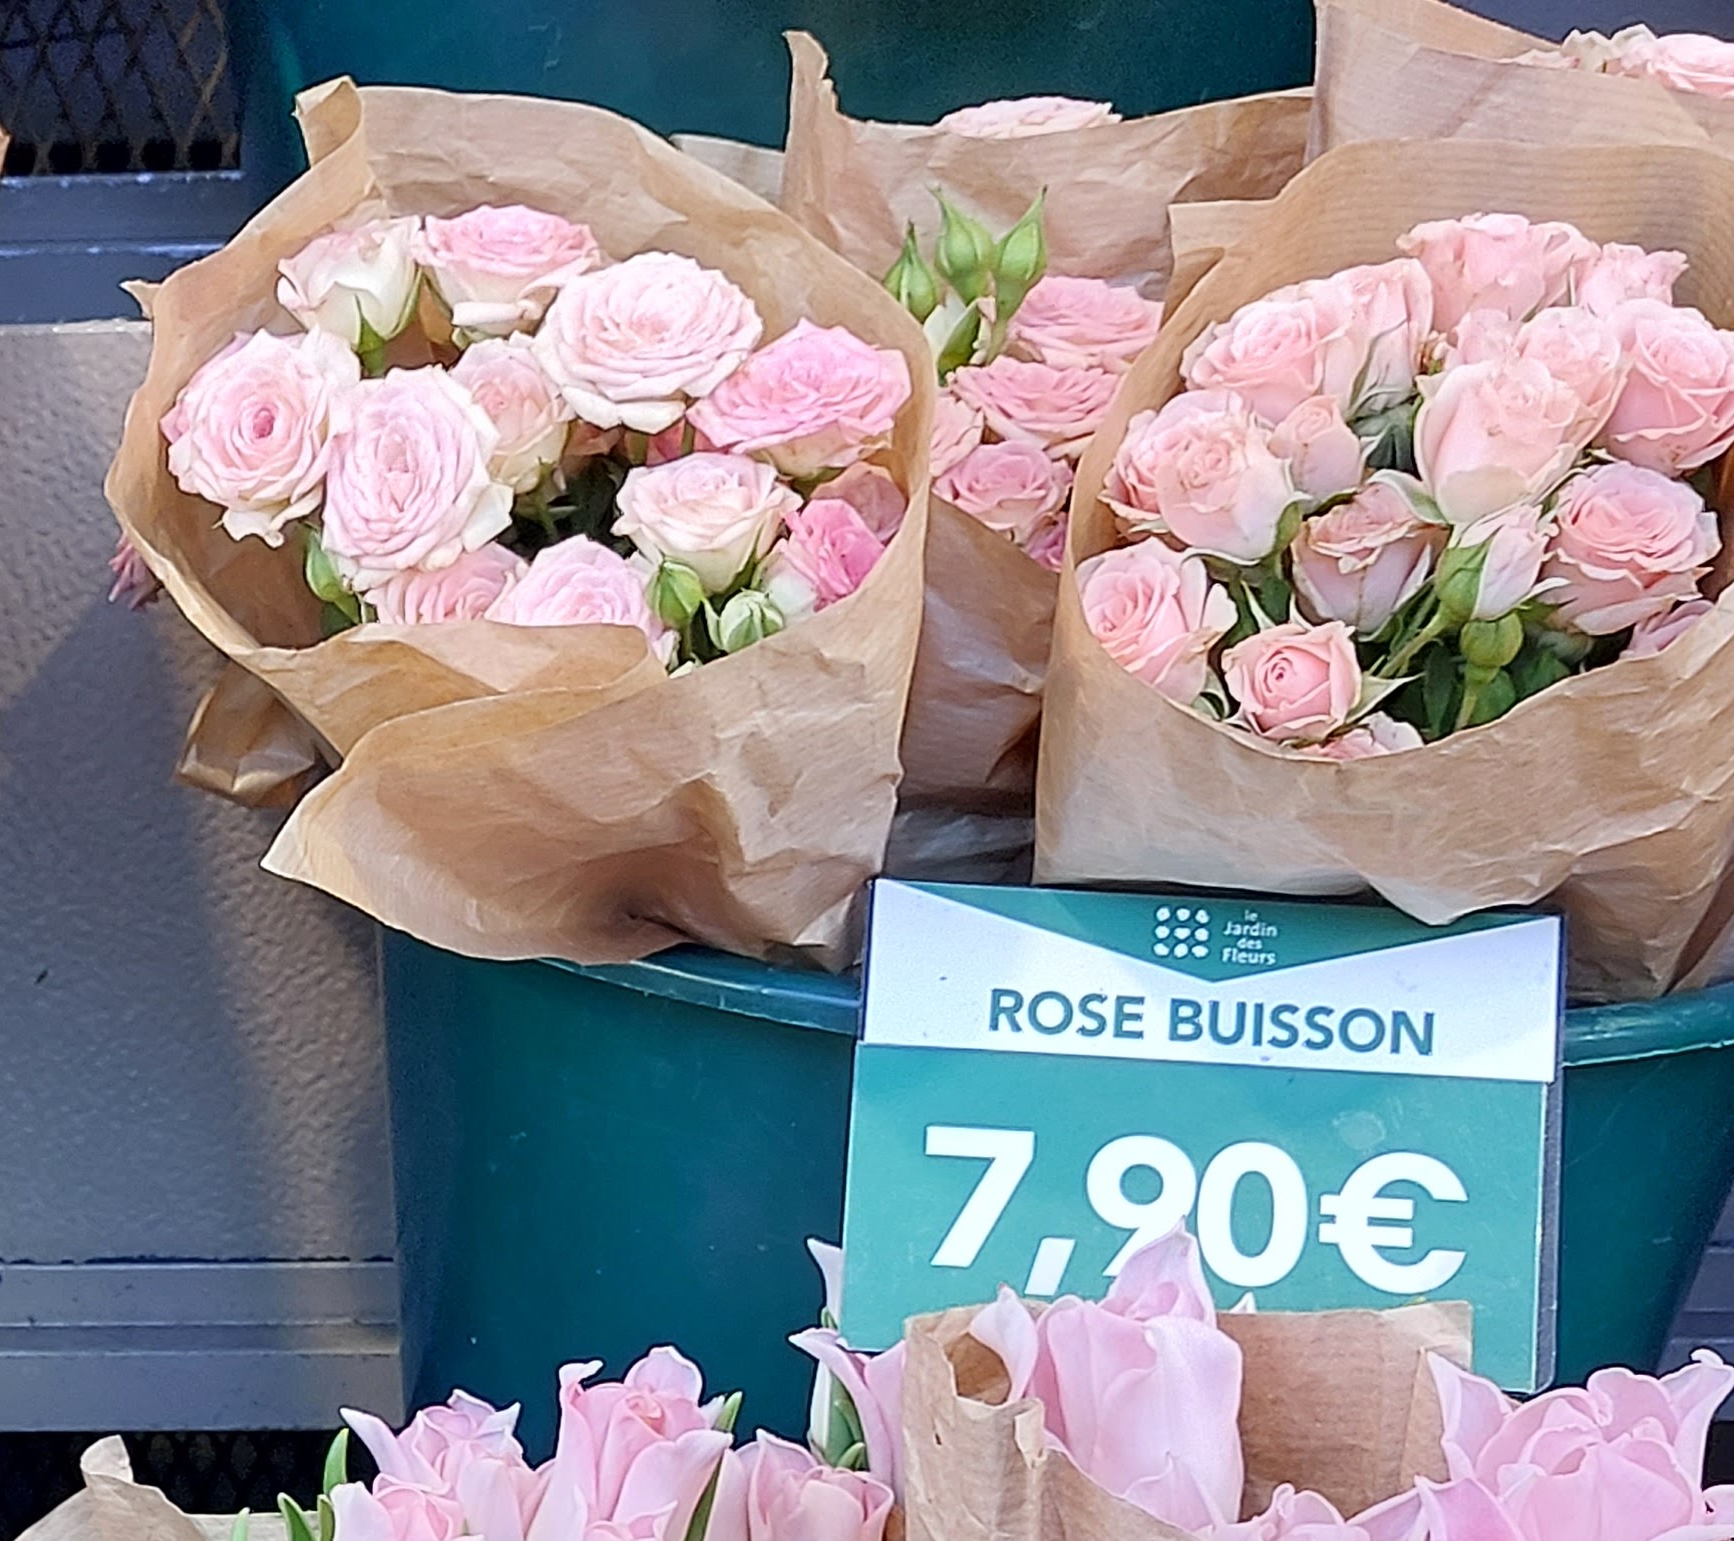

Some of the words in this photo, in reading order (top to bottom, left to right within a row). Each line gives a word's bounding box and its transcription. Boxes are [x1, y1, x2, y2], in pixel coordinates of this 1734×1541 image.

[1244, 909, 1258, 921] le
[1223, 921, 1278, 937] Jardin
[1236, 937, 1263, 950] des
[1222, 947, 1276, 965] Fleurs
[988, 987, 1145, 1040] ROSE
[1168, 998, 1435, 1057] BUISSON
[924, 1125, 1468, 1296] 7,90€
